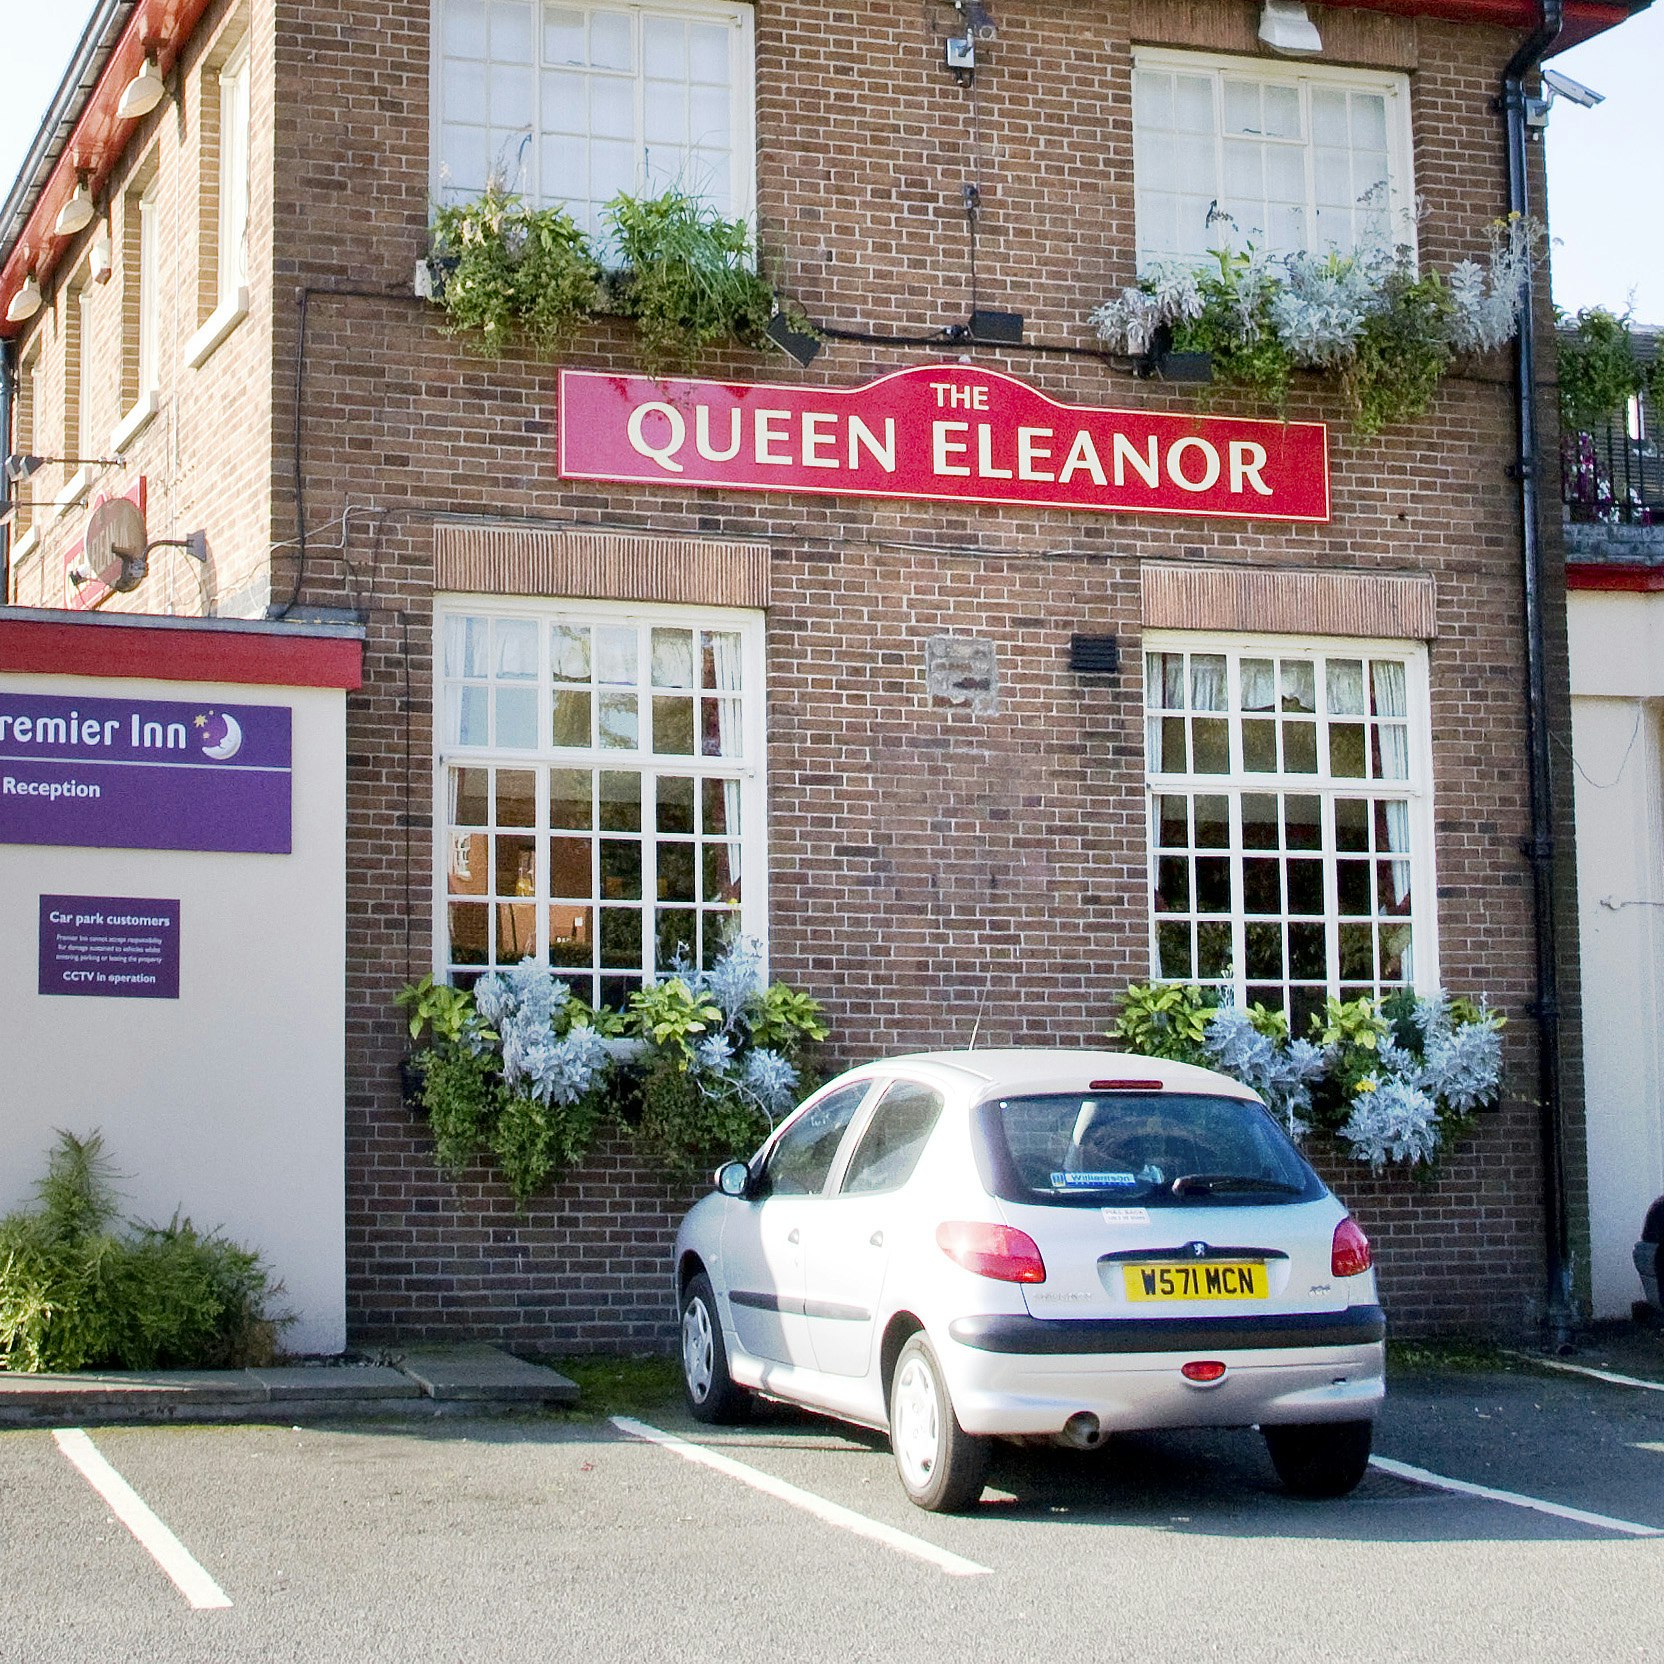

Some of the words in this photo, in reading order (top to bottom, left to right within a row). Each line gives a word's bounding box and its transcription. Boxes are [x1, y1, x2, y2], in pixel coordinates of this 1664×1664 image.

[929, 381, 989, 411] THE
[626, 400, 896, 473] QUEEN
[932, 420, 1274, 496] ELEANOR
[131, 713, 186, 749] Inn
[2, 776, 101, 800] Reception
[49, 911, 73, 924] Car
[75, 913, 104, 927] park
[106, 915, 170, 927] customers
[62, 971, 94, 982] CCTV
[96, 972, 106, 982] in
[108, 973, 156, 985] operation
[1140, 1267, 1200, 1296] W571
[1206, 1266, 1255, 1295] MCN
